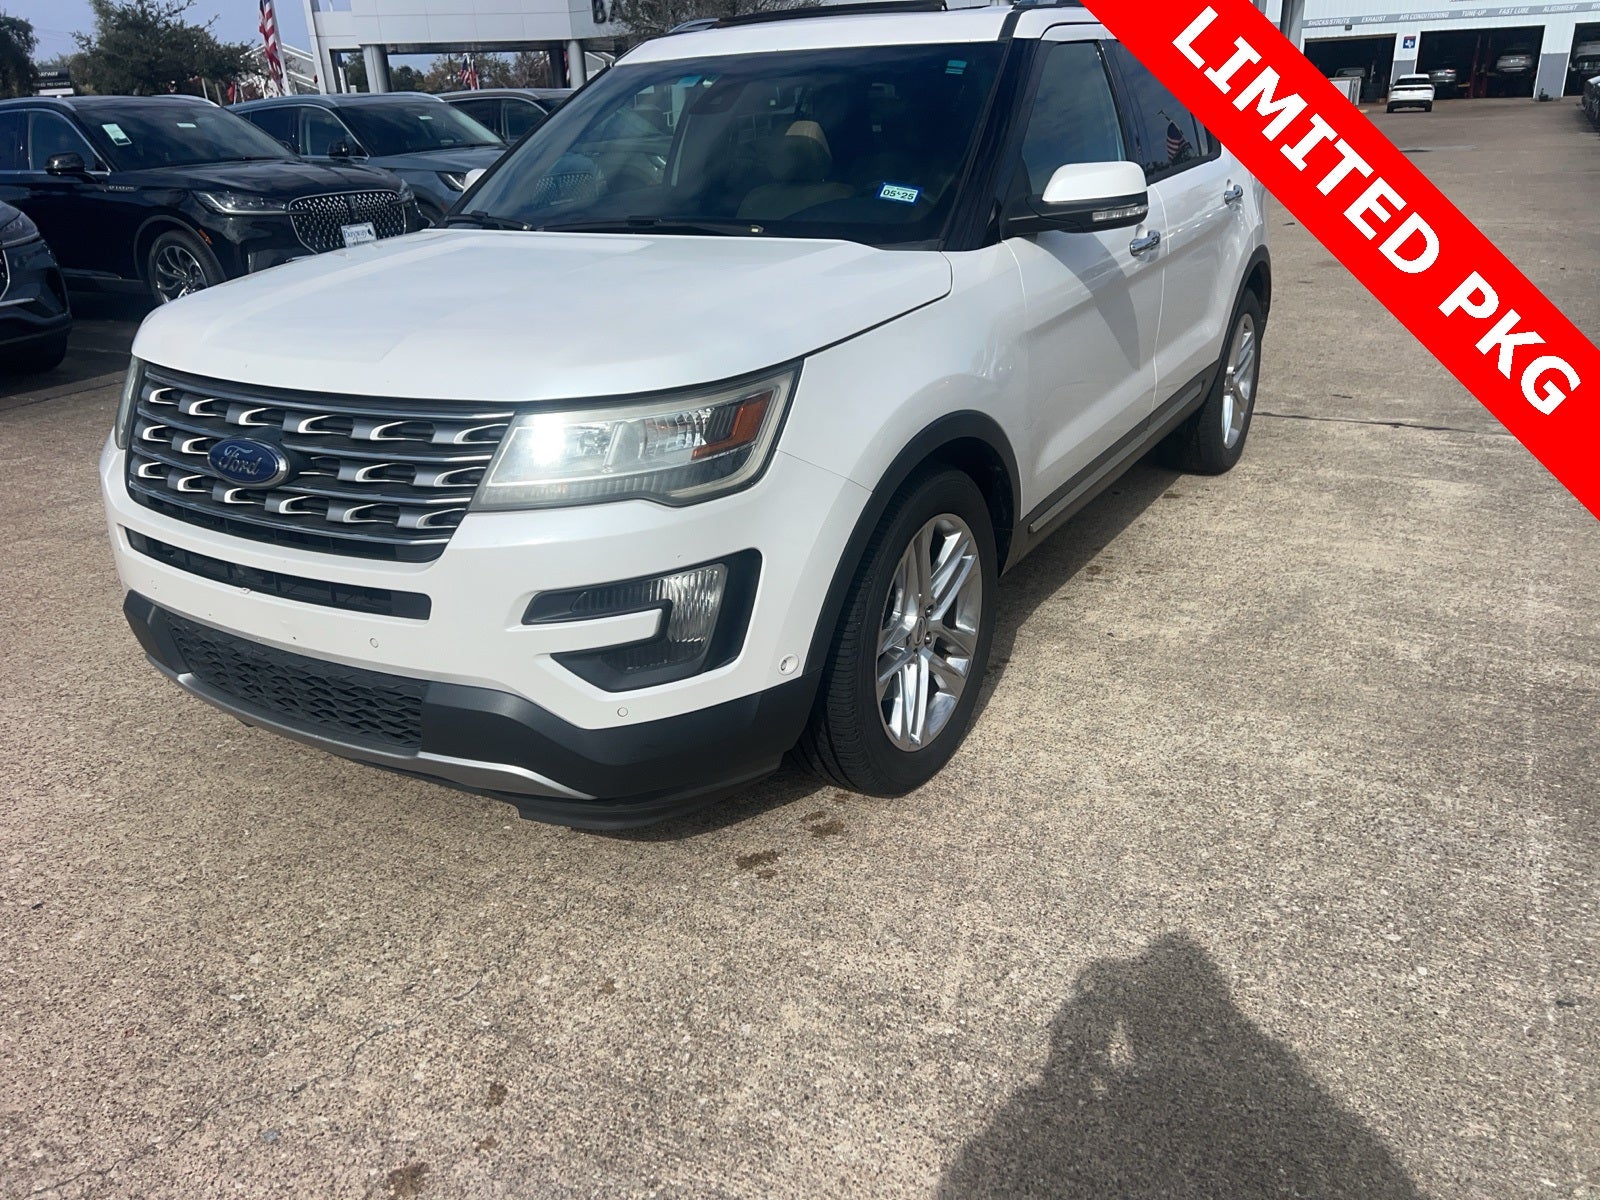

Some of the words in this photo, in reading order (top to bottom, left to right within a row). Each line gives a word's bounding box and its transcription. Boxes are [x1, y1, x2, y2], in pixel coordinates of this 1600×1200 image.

[1361, 15, 1387, 23] EXHAUST
[1398, 13, 1409, 21] AIR
[1409, 11, 1450, 20] CONDITIONING
[1462, 9, 1487, 17] TUNE-UP
[1542, 4, 1578, 13] ALIGNMENT
[883, 189, 896, 197] 05
[900, 192, 915, 200] 25
[218, 445, 263, 475] Ford
